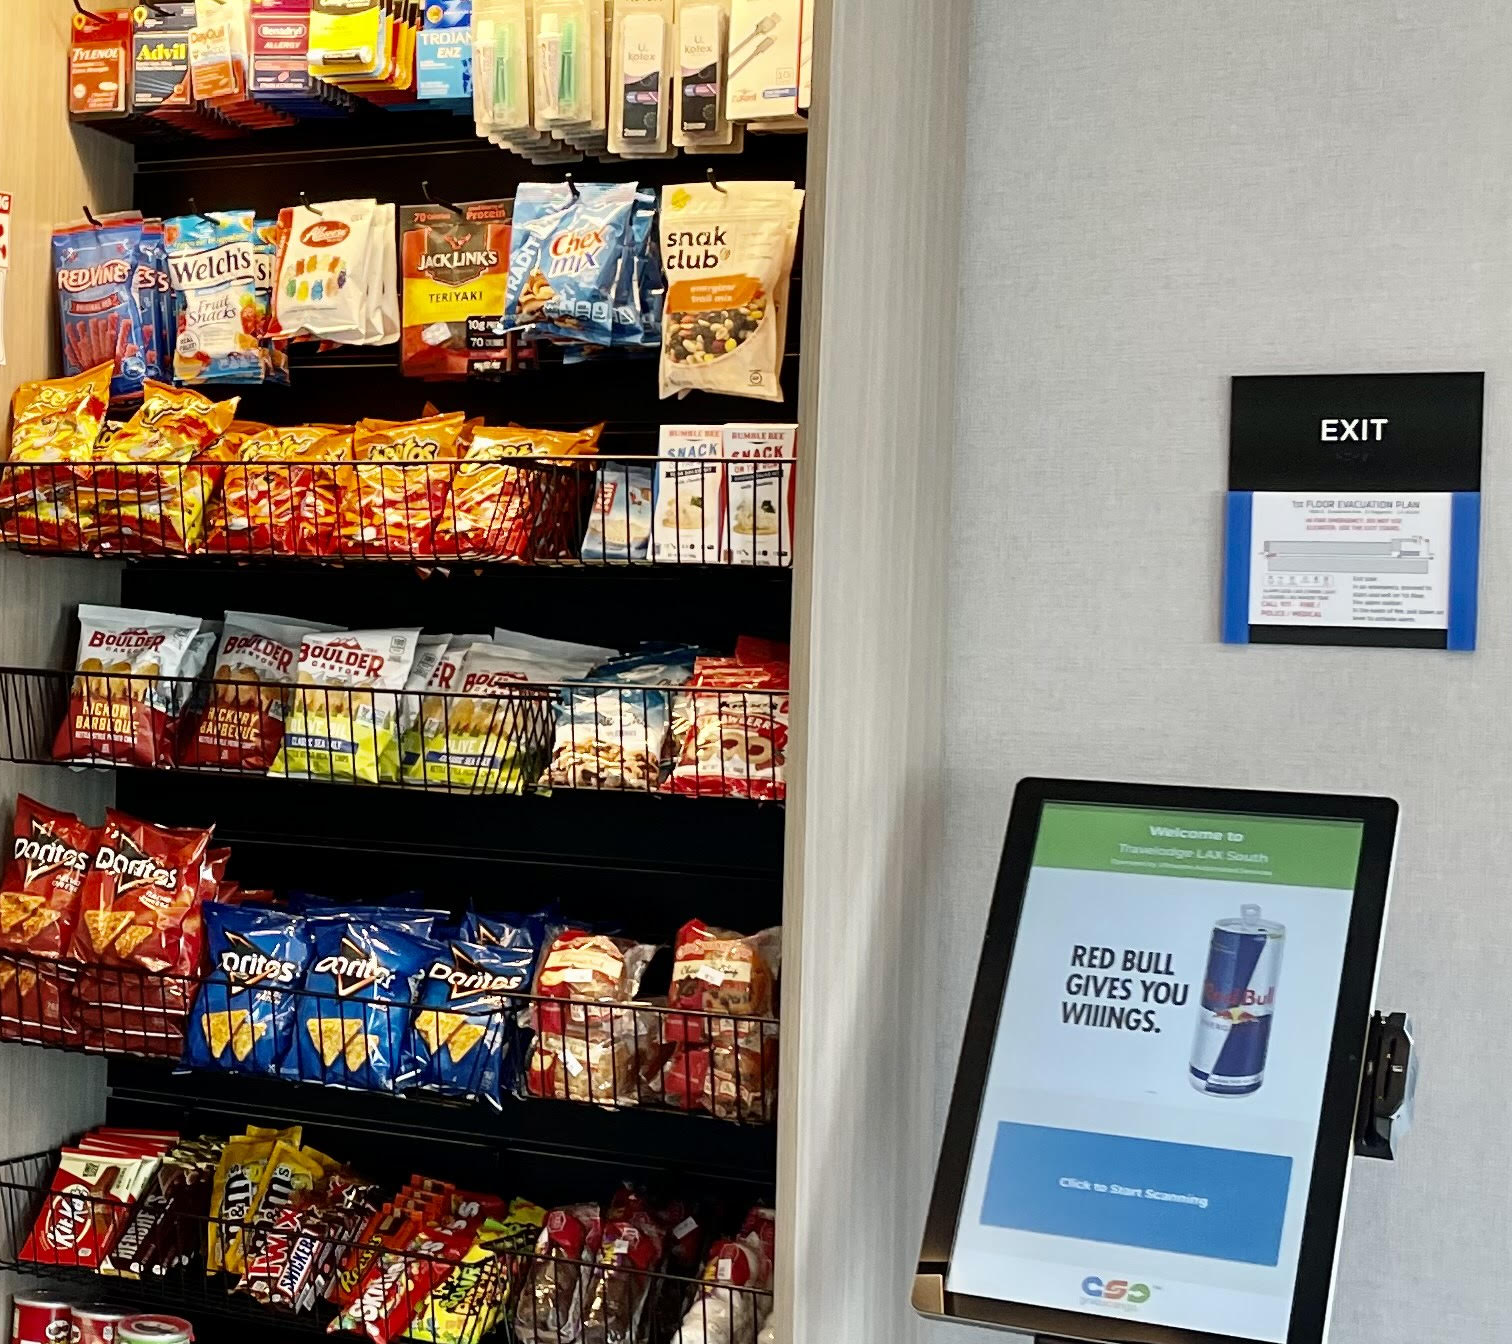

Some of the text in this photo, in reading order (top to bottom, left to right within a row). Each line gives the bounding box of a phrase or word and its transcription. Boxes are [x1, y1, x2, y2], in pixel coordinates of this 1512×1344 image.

[420, 32, 472, 45] TROJAN
[72, 47, 120, 62] TYLENOL
[136, 42, 187, 61] Advil
[551, 224, 605, 257] Chex
[667, 225, 727, 248] snak
[171, 248, 251, 283] Welch's
[418, 253, 452, 271] JACK
[666, 249, 719, 270] club
[198, 294, 230, 312] Fruit
[428, 290, 484, 303] TERIYAKI
[187, 305, 237, 327] Snacks
[1321, 418, 1389, 441] EXIT
[668, 443, 719, 457] SNACK
[88, 630, 166, 652] BOULDER
[223, 634, 294, 674] BOULDER
[298, 643, 385, 679] BOULDER
[311, 660, 360, 676] CANYON
[75, 714, 139, 735] BARBQUE
[1149, 825, 1244, 842] Welcome to
[14, 837, 90, 877] Doritos
[1119, 843, 1269, 864] Travelodge LAX South
[96, 846, 178, 890] Doritos
[1070, 944, 1175, 976] RED BULL
[429, 962, 524, 990] Doritos
[1065, 973, 1189, 1006] GIVES YOU
[1240, 986, 1276, 1006] Bull
[1061, 1001, 1162, 1034] WIIINGS.
[1059, 1177, 1091, 1191] Click
[1110, 1184, 1143, 1198] Start
[1144, 1189, 1209, 1209] Scanning
